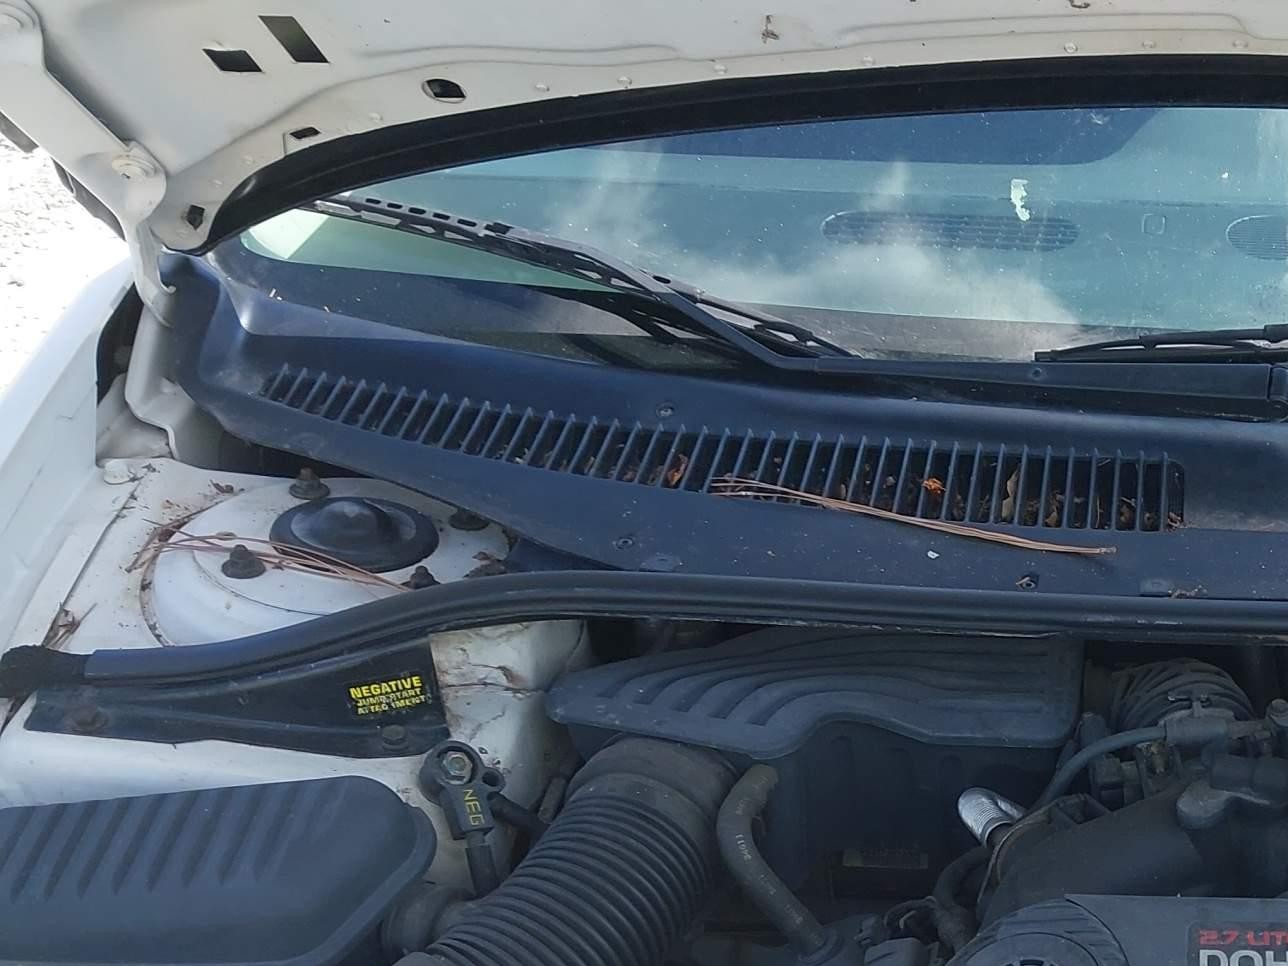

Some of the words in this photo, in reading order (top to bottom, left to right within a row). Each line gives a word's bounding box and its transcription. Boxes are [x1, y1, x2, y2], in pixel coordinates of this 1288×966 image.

[349, 676, 422, 699] NEGATIVE
[463, 789, 485, 826] NEG
[1198, 930, 1239, 945] 2.7
